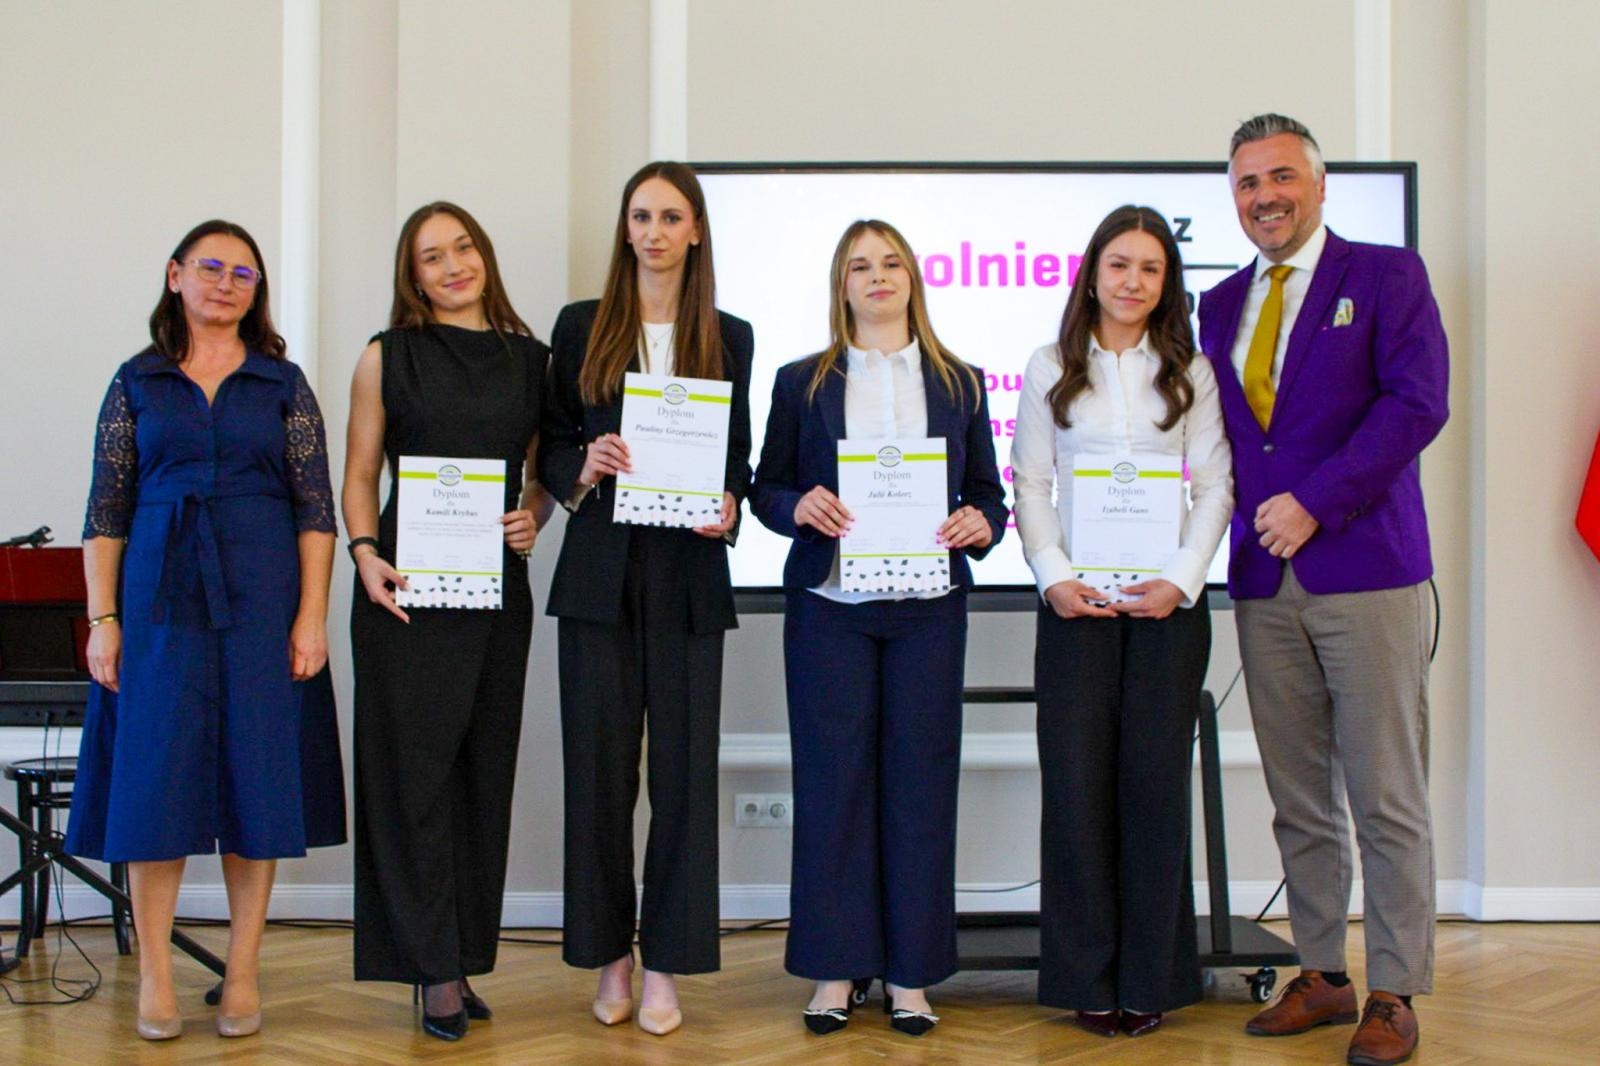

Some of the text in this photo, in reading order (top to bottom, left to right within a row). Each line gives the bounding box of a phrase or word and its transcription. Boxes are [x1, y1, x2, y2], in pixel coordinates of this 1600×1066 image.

[657, 406, 695, 419] Dyplom
[872, 469, 912, 482] Dyplom
[433, 488, 471, 500] Dyplom
[1107, 485, 1146, 498] Dyplom
